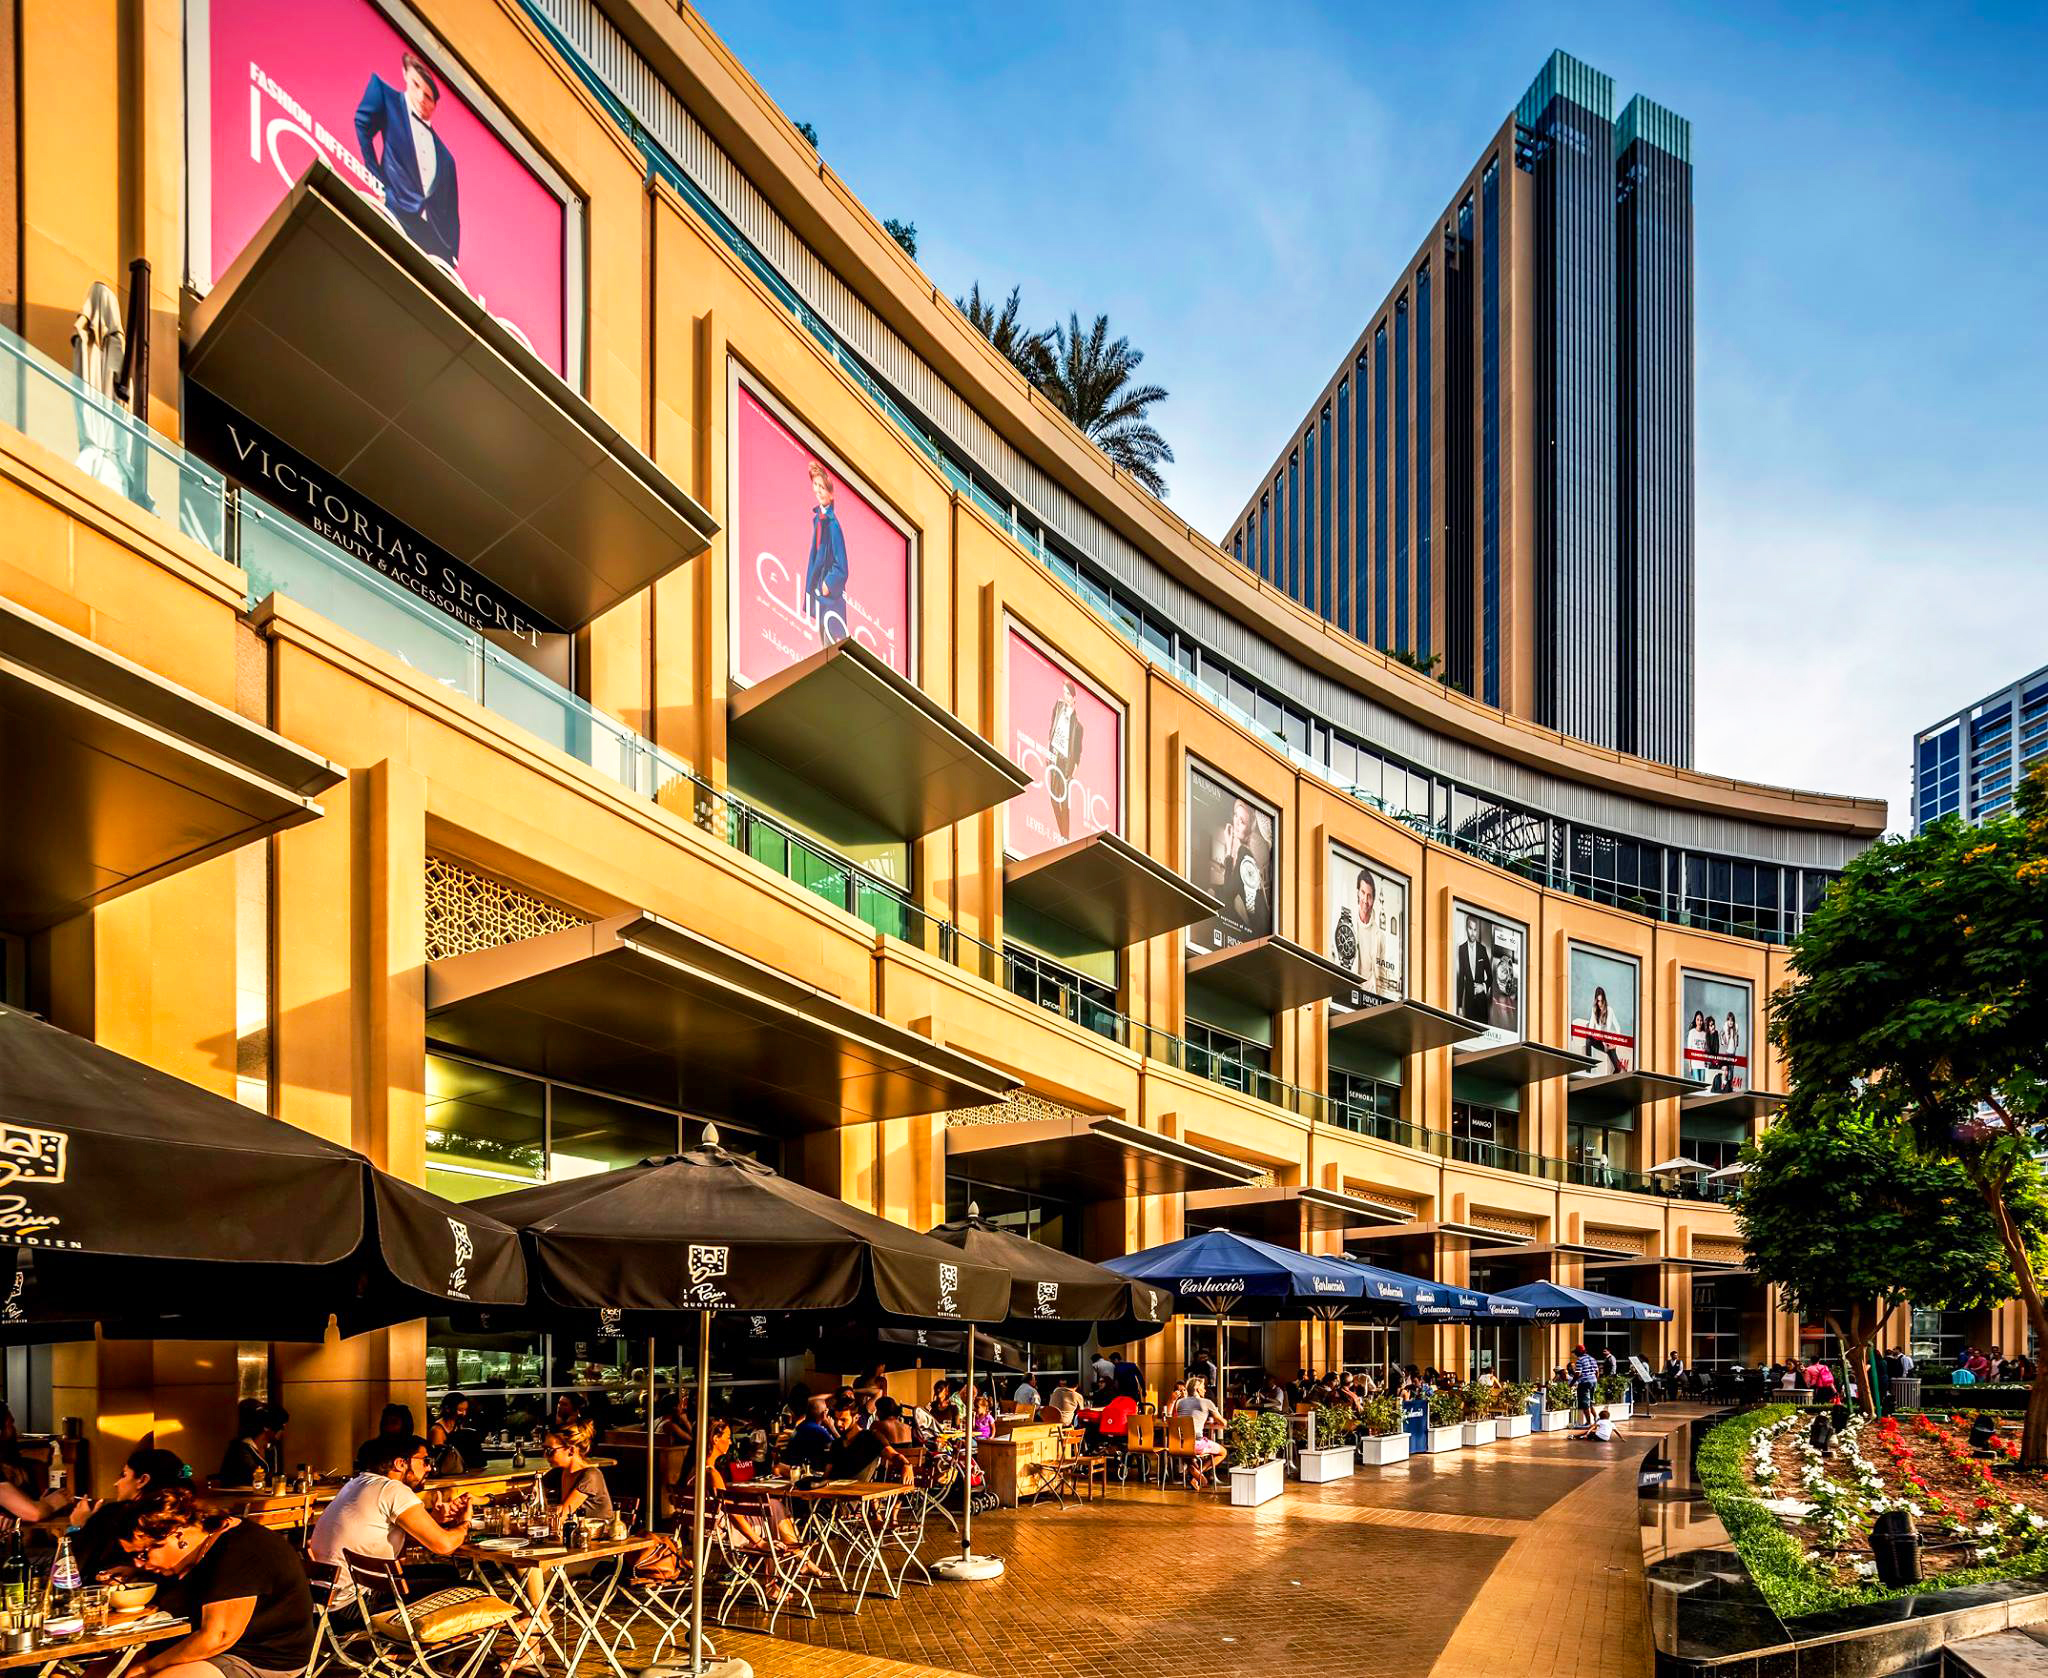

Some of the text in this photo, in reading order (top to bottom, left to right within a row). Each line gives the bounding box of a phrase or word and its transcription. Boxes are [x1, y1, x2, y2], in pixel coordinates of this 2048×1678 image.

[250, 61, 312, 133] FASHION
[226, 423, 543, 649] VICTORIA'S SECRET
[313, 515, 484, 632] BEAUTY & ACCESSORIES
[1376, 957, 1395, 971] RADO
[1349, 1090, 1374, 1102] SEPHORA
[1472, 1118, 1492, 1129] MANGO
[690, 1283, 727, 1303] Pain
[1179, 1276, 1245, 1295] Carluccio's
[1313, 1276, 1345, 1293] Carluccio's
[1489, 1304, 1520, 1315] Carluccio's
